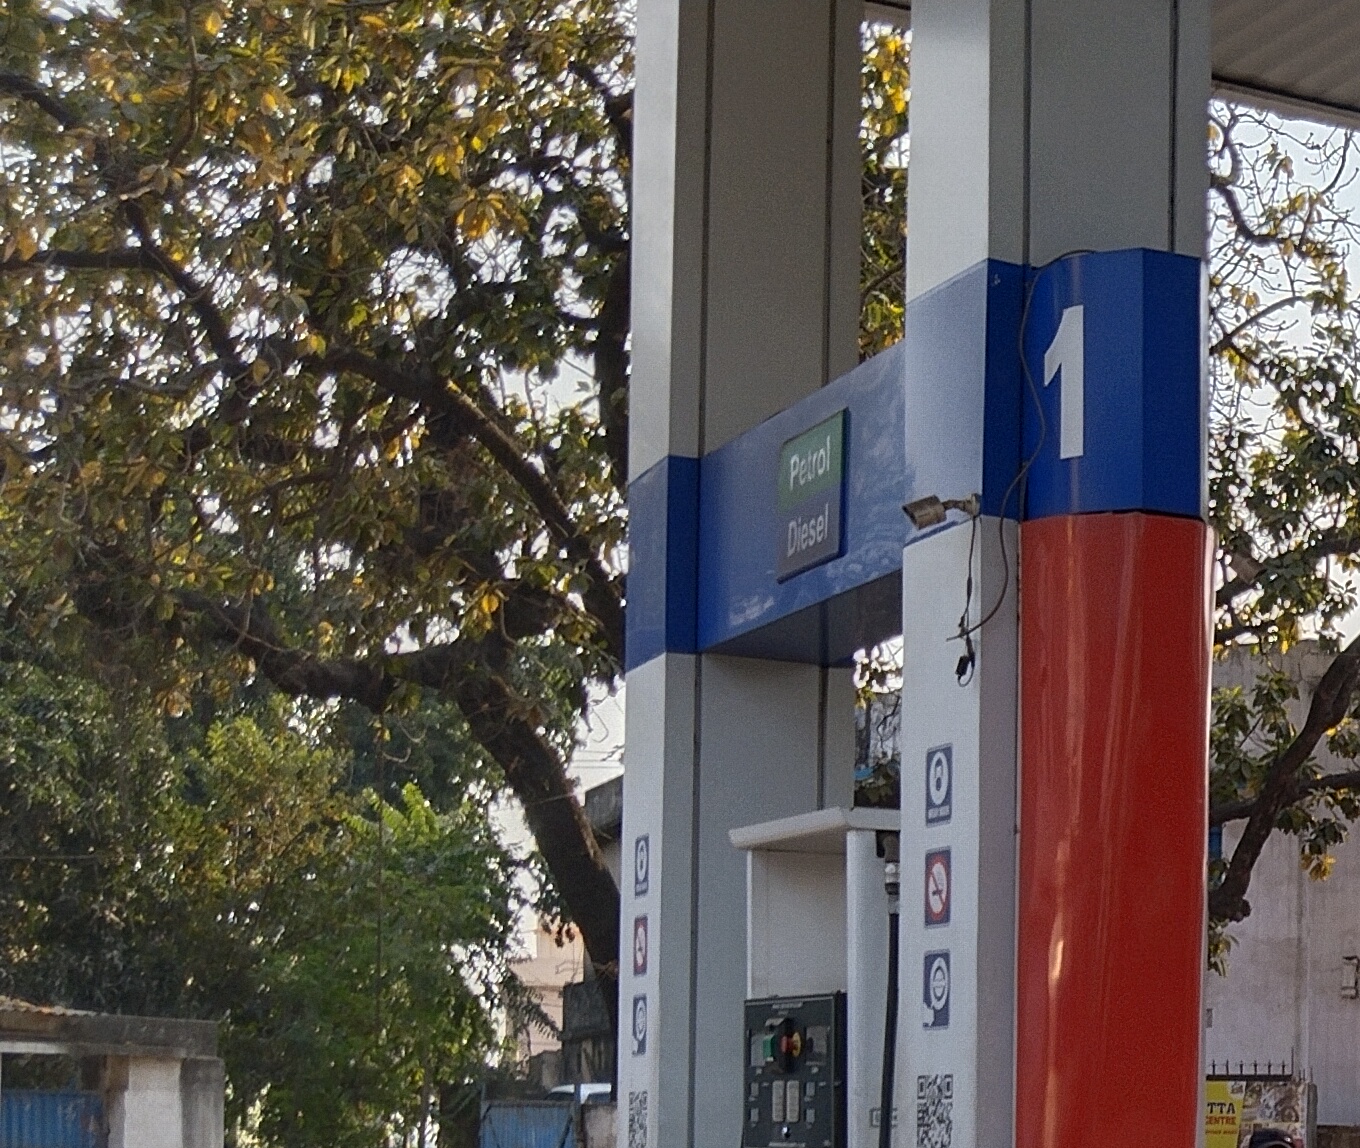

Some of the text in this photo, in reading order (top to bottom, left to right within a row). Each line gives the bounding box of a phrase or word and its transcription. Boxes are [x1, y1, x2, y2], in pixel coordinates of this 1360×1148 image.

[1044, 304, 1084, 460] 1
[789, 435, 831, 491] Petrol
[781, 503, 829, 558] Diesel
